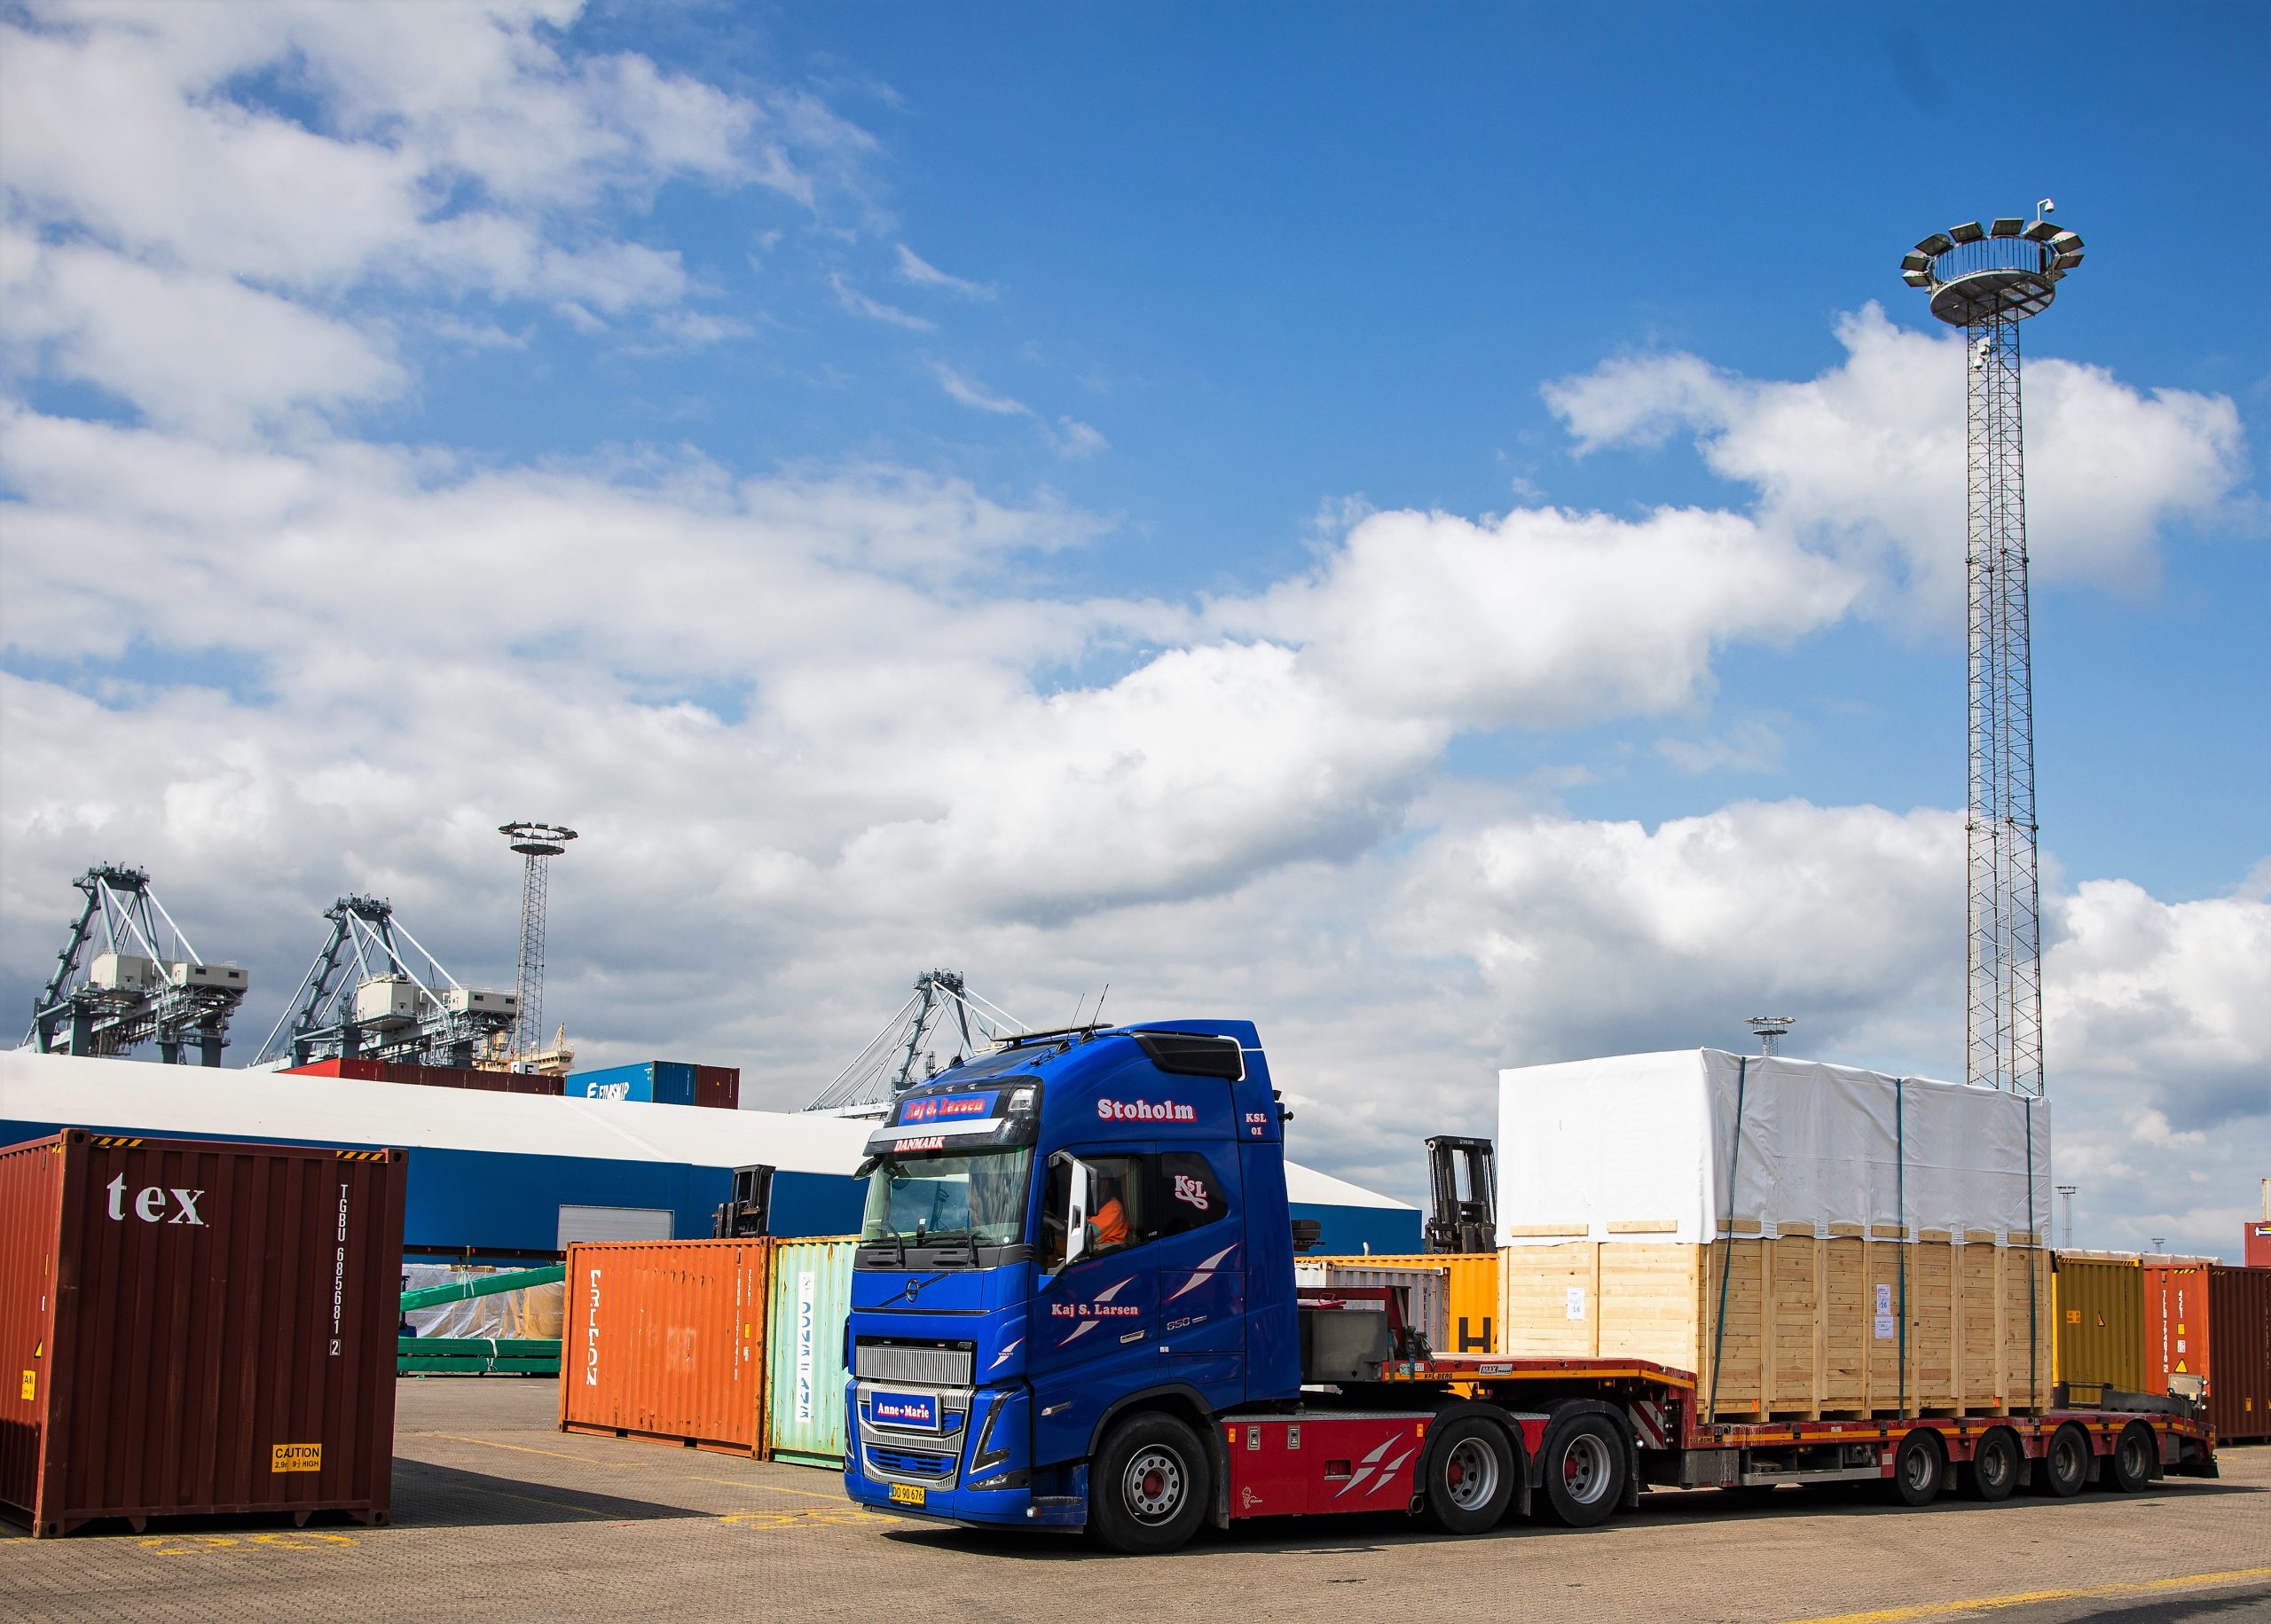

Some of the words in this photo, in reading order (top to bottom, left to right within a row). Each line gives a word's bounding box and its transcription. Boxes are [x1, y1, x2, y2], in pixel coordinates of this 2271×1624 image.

[939, 1098, 986, 1115] Larsen
[1097, 1099, 1196, 1122] Stoholm
[1246, 1112, 1267, 1124] KSL
[1251, 1126, 1262, 1136] 01
[893, 1136, 945, 1153] DANMARK
[106, 1172, 205, 1226] tex
[337, 1184, 349, 1242] TGBU
[333, 1247, 344, 1334] 685681
[1051, 1304, 1075, 1318] Kaj
[1079, 1304, 1091, 1315] S.
[1095, 1304, 1139, 1316] Larsen
[586, 1269, 601, 1385] TRITON
[331, 1340, 340, 1355] 2
[877, 1402, 900, 1416] Anne
[905, 1404, 931, 1419] Marie
[275, 1447, 319, 1458] CAUTION
[902, 1487, 910, 1500] 90
